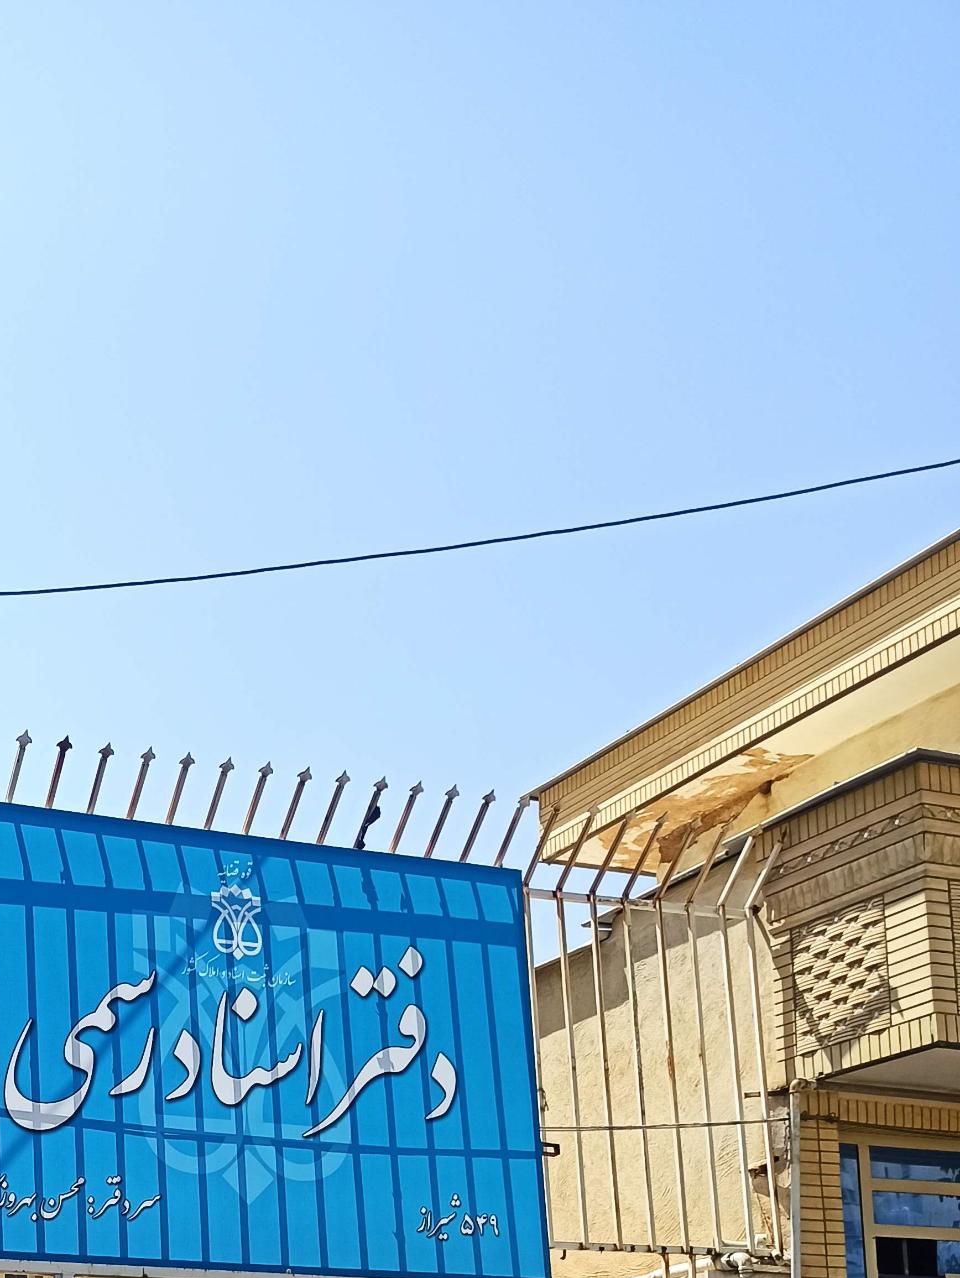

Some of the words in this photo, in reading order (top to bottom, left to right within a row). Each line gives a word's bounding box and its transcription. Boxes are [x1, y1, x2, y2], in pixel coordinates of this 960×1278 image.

[246, 963, 270, 987] ثبت
[268, 971, 297, 987] سازمان
[3, 969, 157, 1132] رسمی
[164, 986, 325, 1107] اسناد
[302, 945, 457, 1138] دفتر
[39, 1176, 86, 1220] محسن
[416, 1192, 461, 1241] شیراز
